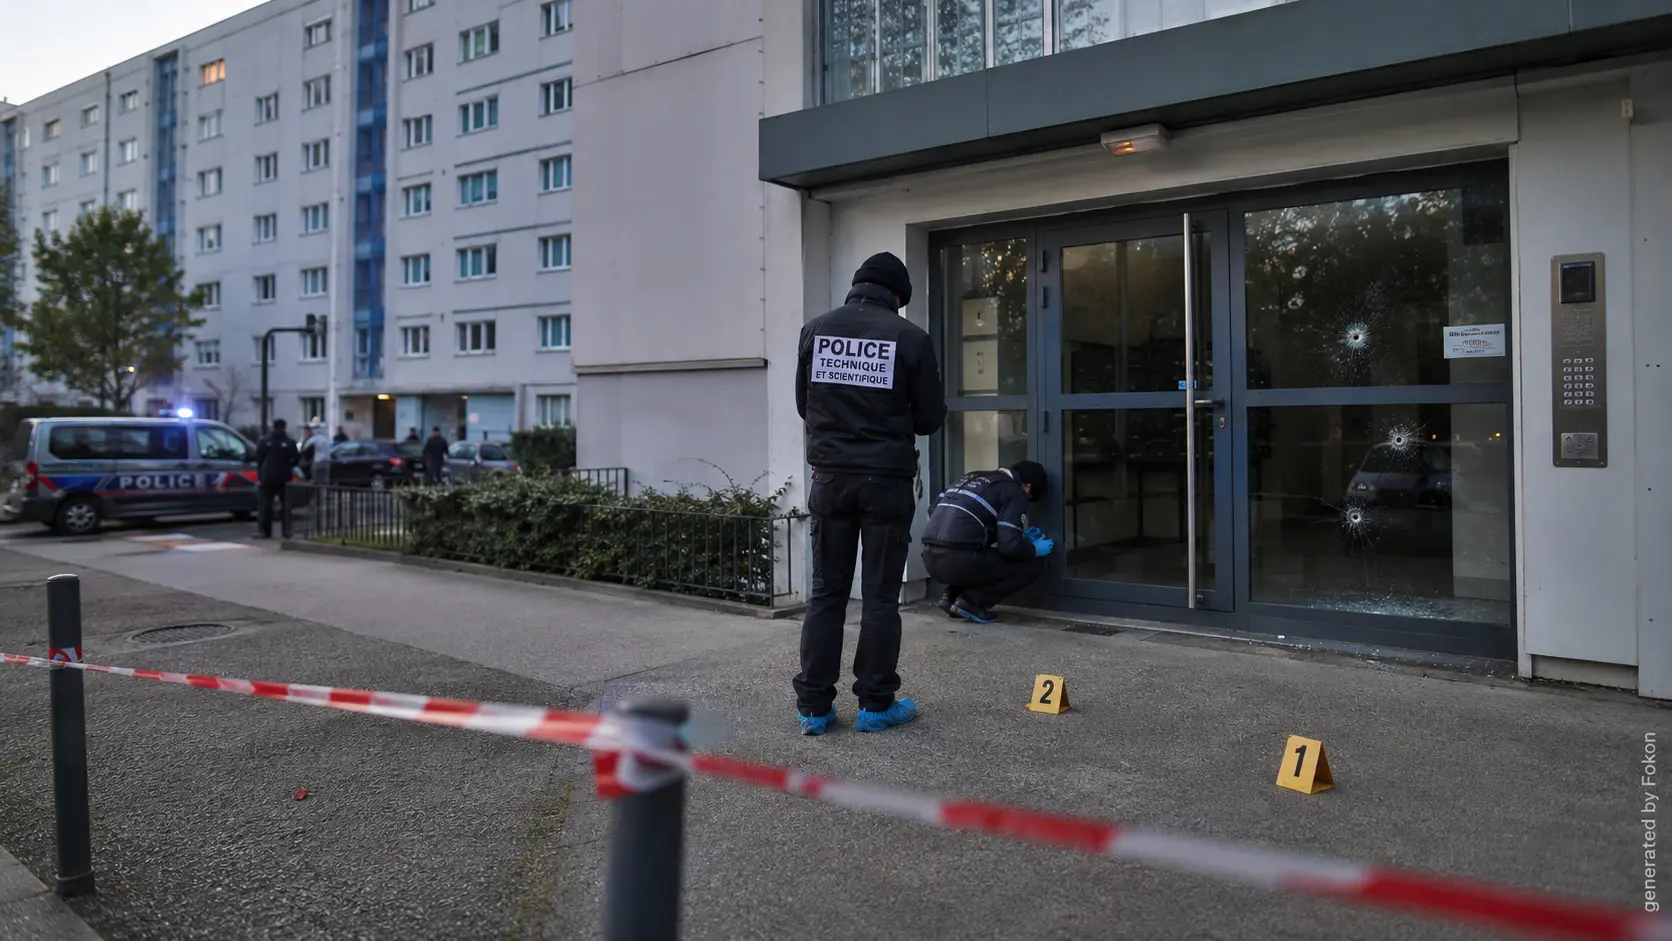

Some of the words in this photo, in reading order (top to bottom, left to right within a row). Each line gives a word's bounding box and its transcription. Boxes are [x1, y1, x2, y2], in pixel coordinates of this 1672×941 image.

[818, 338, 891, 360] POLICE
[820, 358, 886, 373] TECHNIQUE
[815, 371, 826, 379] ET
[828, 372, 888, 385] SCIENTIFIQUE
[1039, 679, 1054, 704] 2
[1293, 744, 1307, 778] 1
